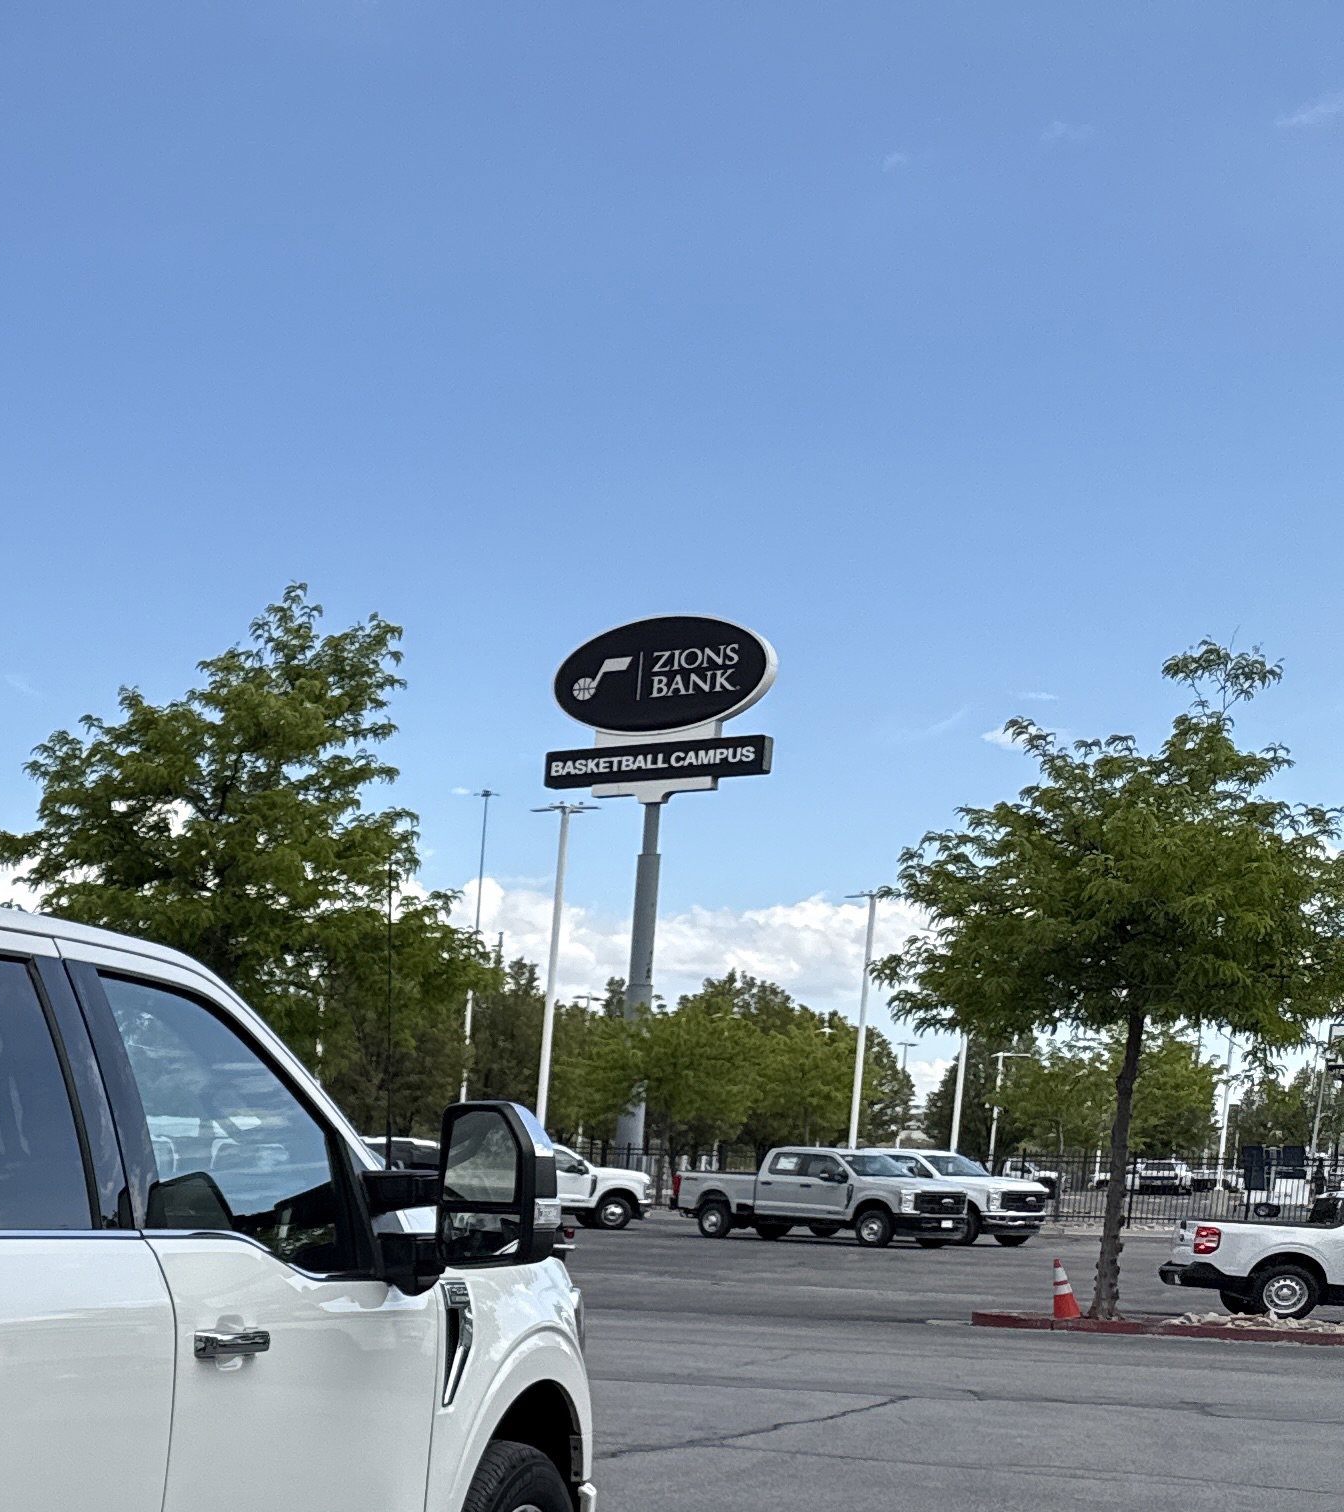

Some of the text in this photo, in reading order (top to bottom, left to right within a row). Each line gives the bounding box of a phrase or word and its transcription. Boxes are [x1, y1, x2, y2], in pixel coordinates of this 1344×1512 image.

[651, 643, 740, 673] ZIONS
[649, 668, 736, 698] BANK
[550, 746, 756, 777] BASKETBALL CAMPUS
